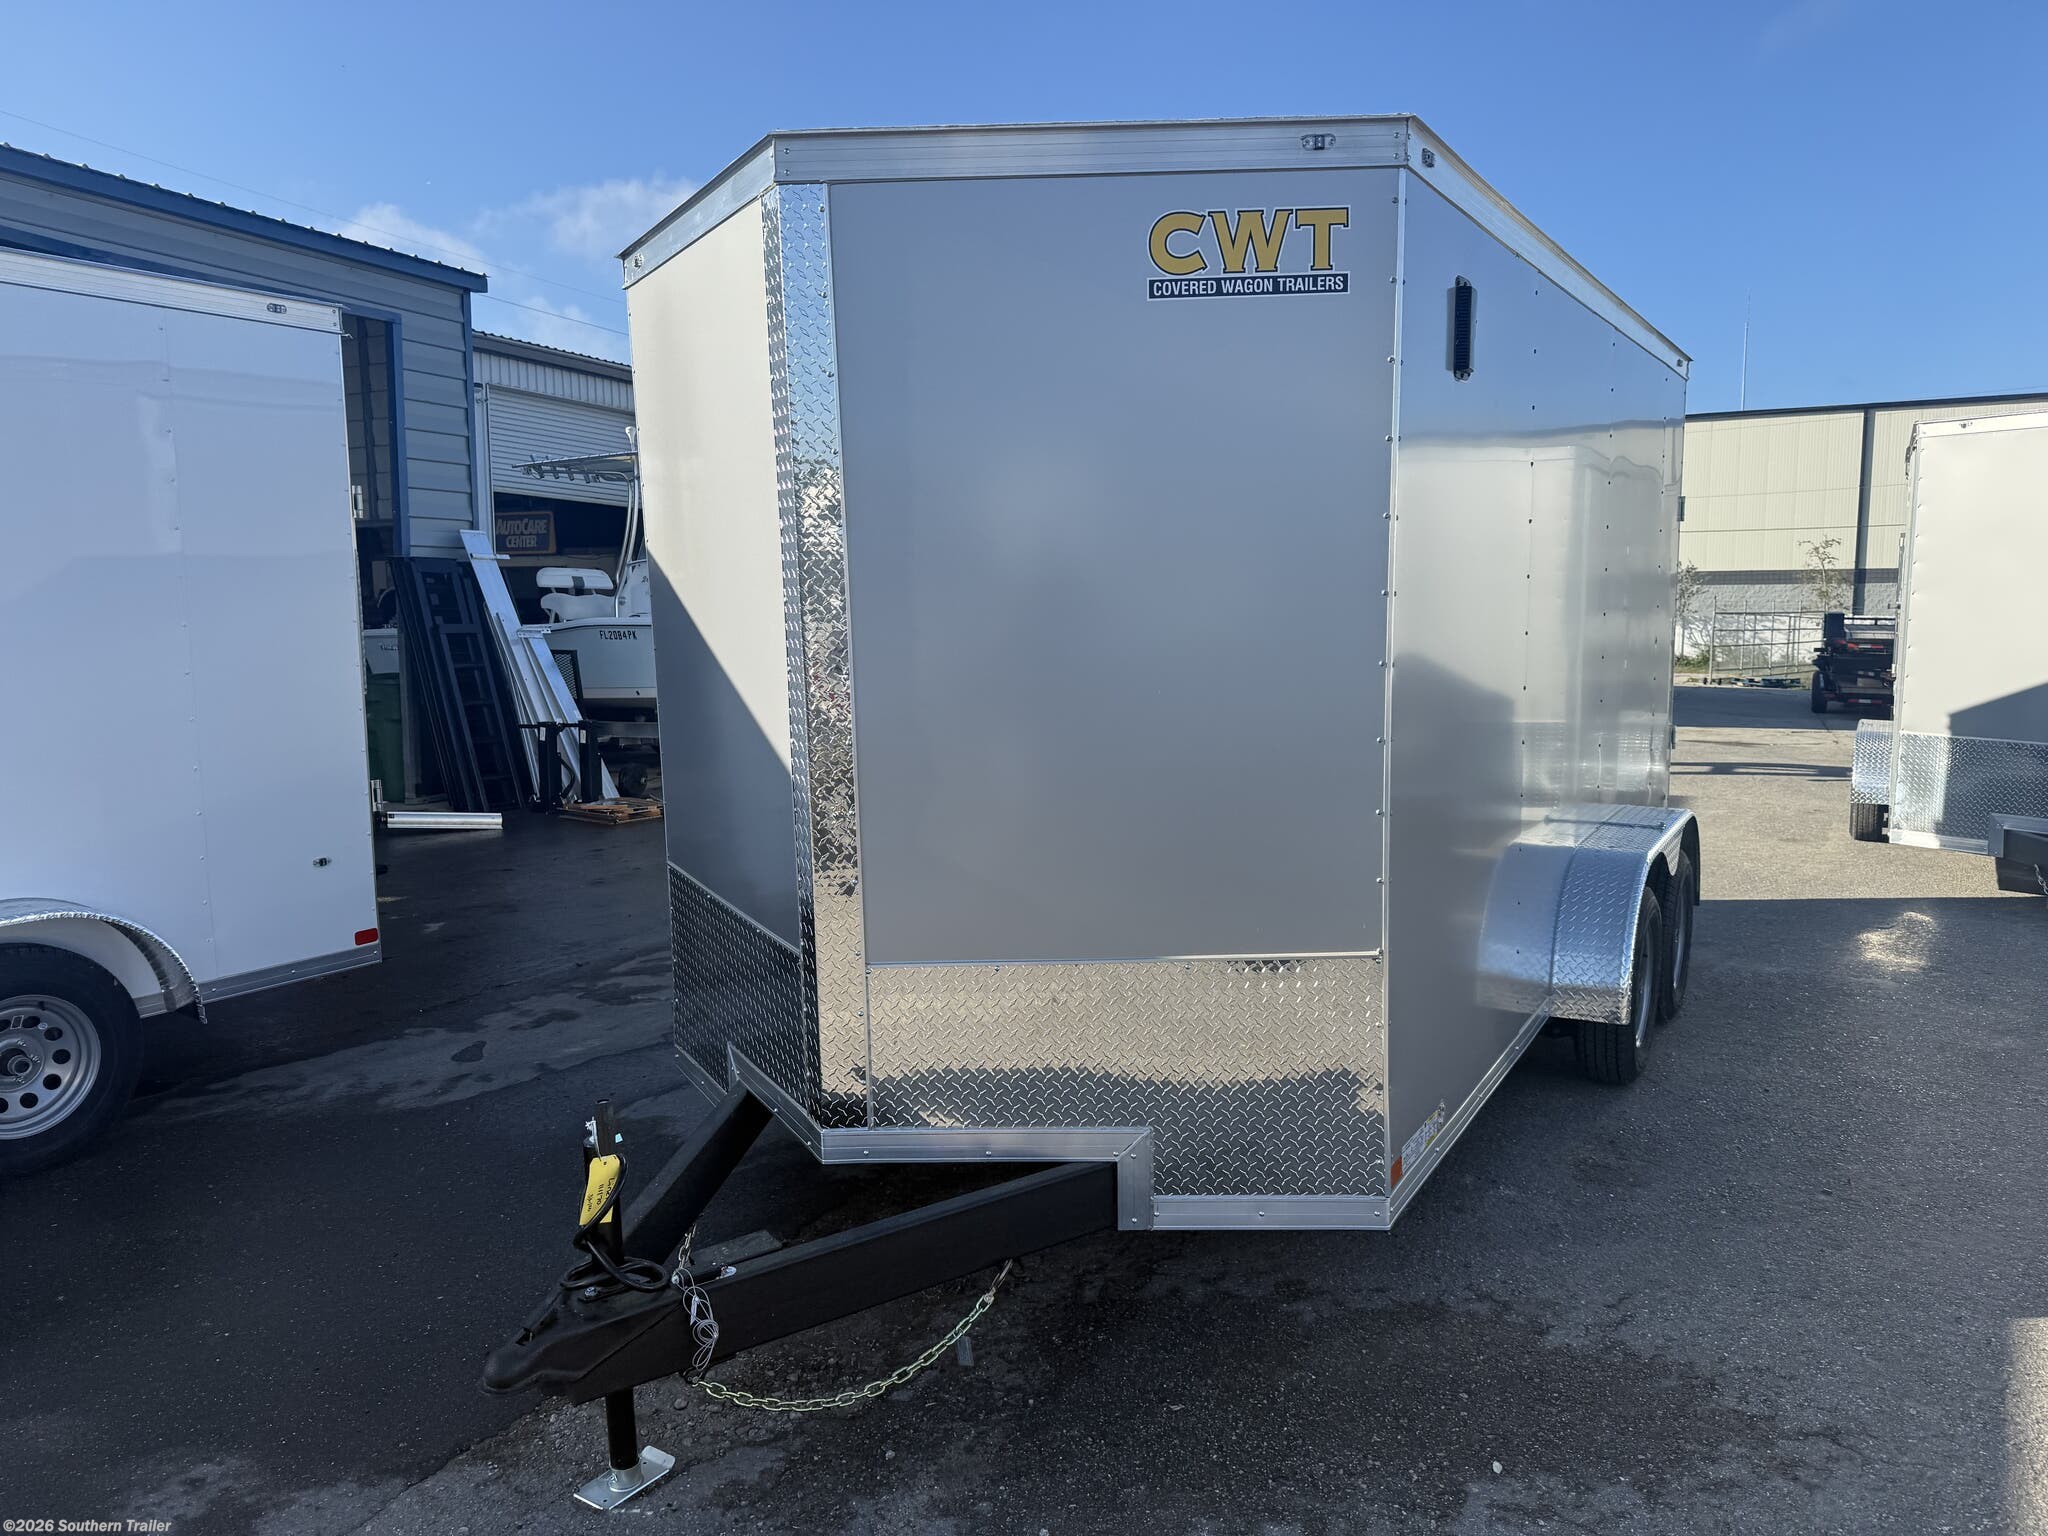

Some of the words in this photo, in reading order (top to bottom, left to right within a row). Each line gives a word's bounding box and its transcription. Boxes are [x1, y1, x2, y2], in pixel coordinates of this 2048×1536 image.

[1149, 207, 1349, 276] CWT
[1153, 279, 1217, 296] COVERED
[1221, 278, 1273, 294] WAGON
[1277, 276, 1344, 292] TRAILERS
[506, 535, 537, 548] CENTER
